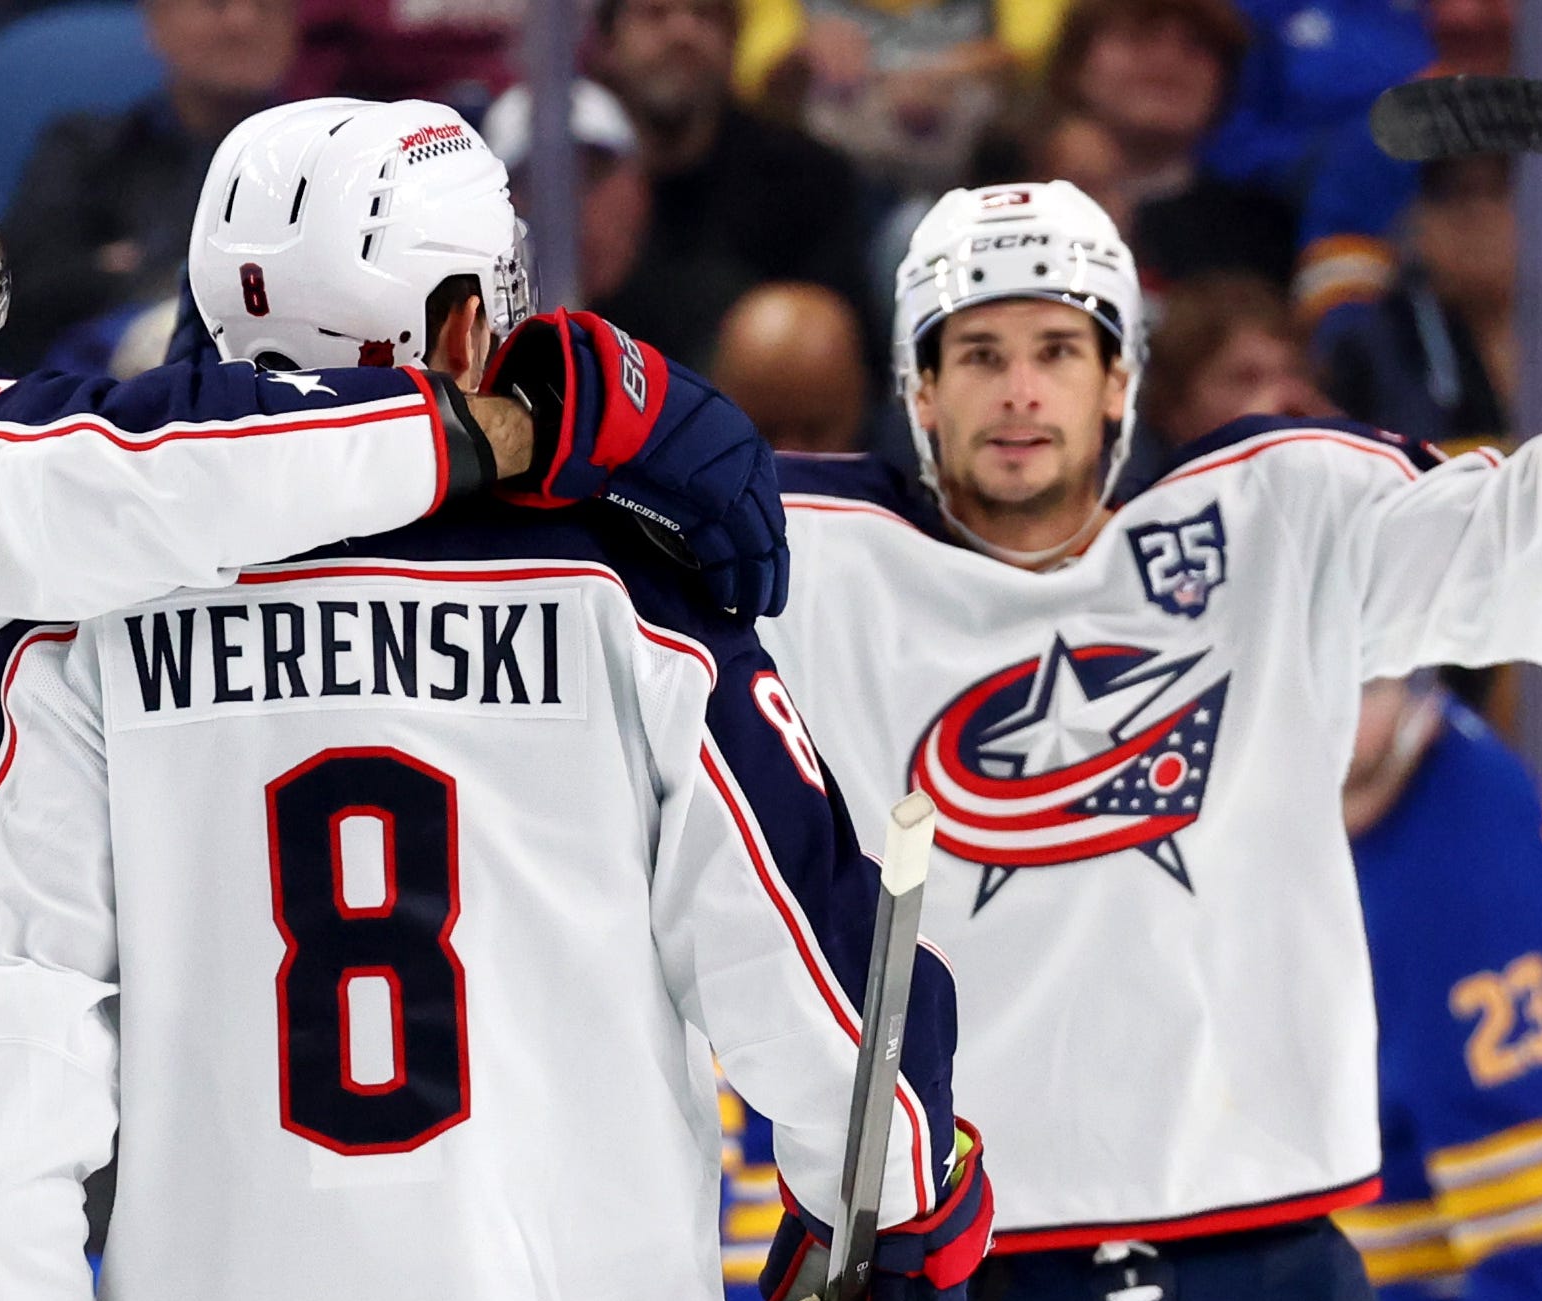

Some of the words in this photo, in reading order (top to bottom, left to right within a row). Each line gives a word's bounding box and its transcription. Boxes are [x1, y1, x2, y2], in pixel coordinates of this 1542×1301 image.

[971, 233, 1050, 253] CCM
[239, 263, 269, 316] 8
[607, 492, 681, 532] MARCHENKO
[1137, 518, 1222, 596] 25
[125, 601, 563, 712] WERENSKI
[751, 671, 827, 795] 8
[265, 747, 471, 1156] 8
